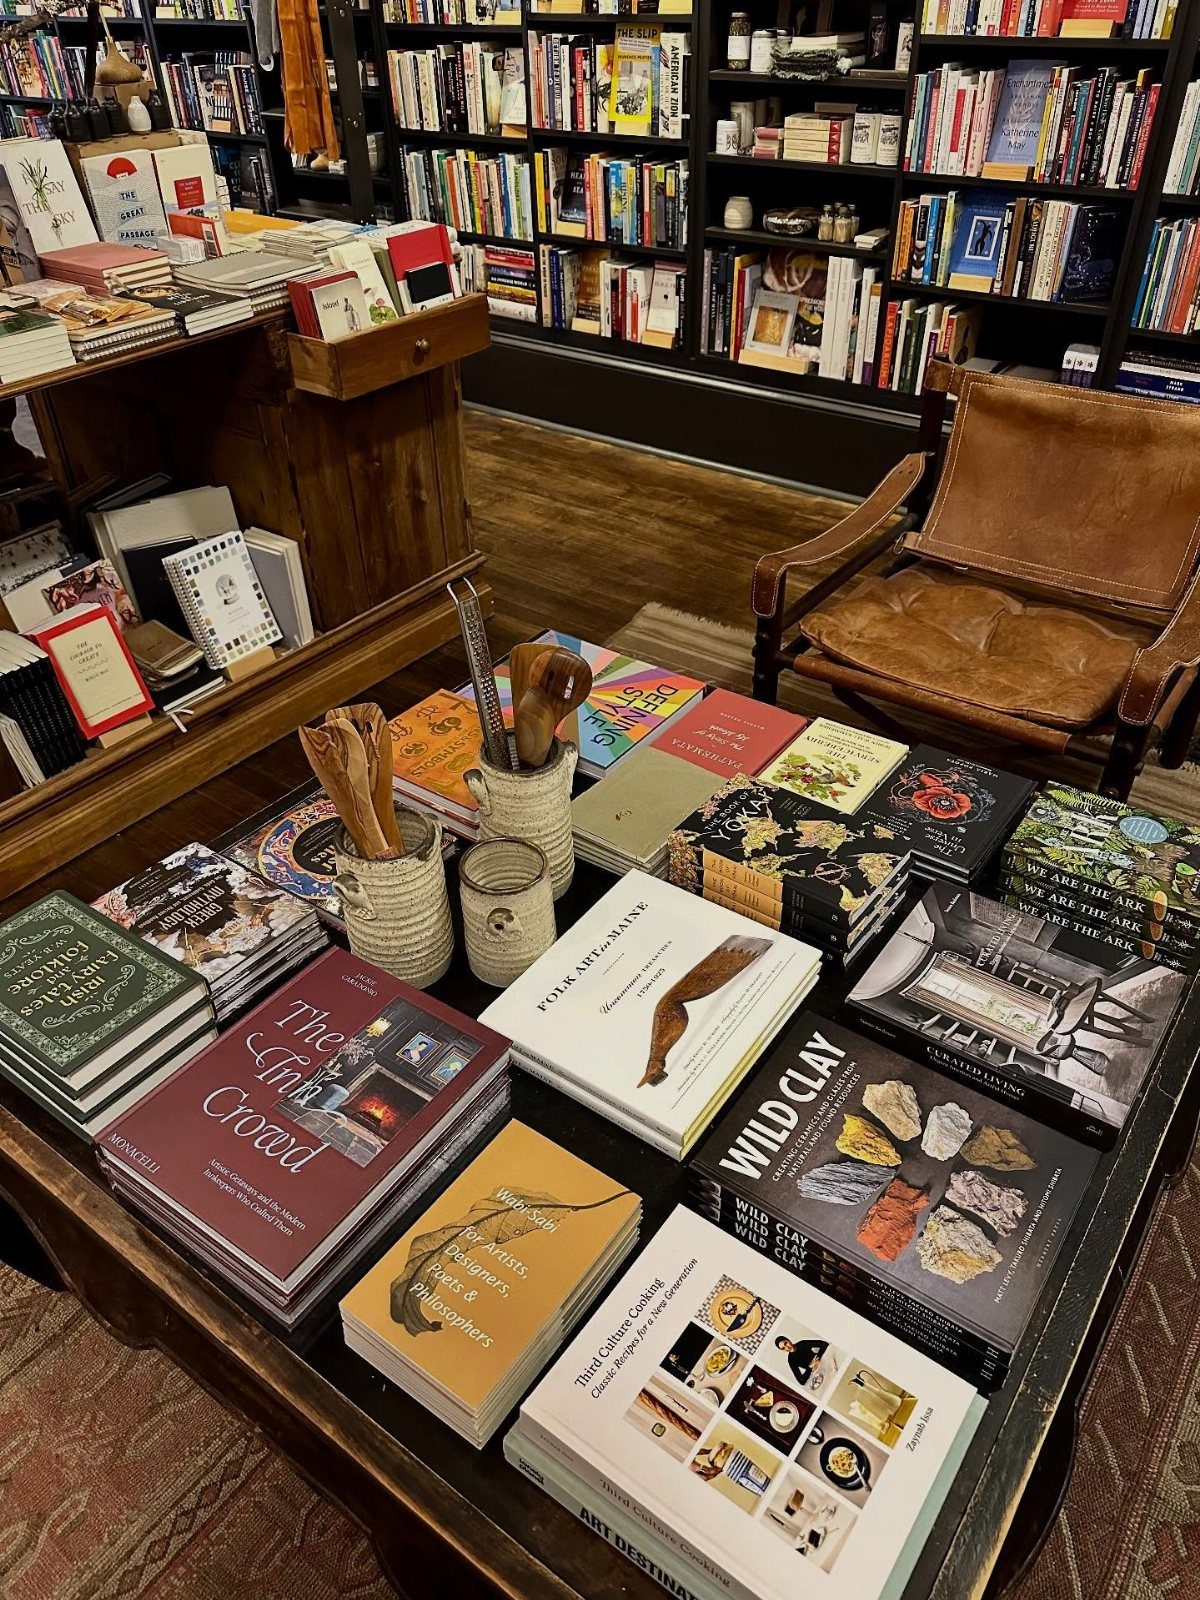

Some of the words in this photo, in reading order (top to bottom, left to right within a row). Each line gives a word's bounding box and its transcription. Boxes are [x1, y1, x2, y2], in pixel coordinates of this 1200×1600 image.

[617, 29, 633, 38] THE
[637, 29, 658, 38] SLIP
[670, 45, 680, 94] AMERICAN
[1007, 79, 1049, 88] Enchantme
[670, 98, 680, 118] ZION
[1001, 128, 1040, 138] Katherine
[1007, 141, 1026, 150] May
[45, 181, 67, 195] SAY
[120, 191, 136, 200] THE
[53, 210, 76, 226] SKY
[120, 207, 145, 220] GREAT
[120, 229, 155, 239] PASSAGE
[880, 316, 896, 377] LAPIDARIUM
[68, 646, 93, 660] COURAGE
[94, 641, 102, 649] TO
[76, 640, 89, 649] THE
[77, 651, 99, 664] CREATE
[582, 685, 646, 729] STYLE
[588, 683, 683, 749] DEFINING
[668, 737, 744, 769] PATHEMATA
[803, 734, 881, 765] SERVICEBERRY
[824, 748, 847, 759] THE
[944, 757, 974, 769] POPOVA
[974, 767, 999, 777] MARIA
[704, 818, 721, 831] THE
[720, 800, 741, 818] BOOK
[740, 791, 749, 800] OF
[921, 825, 949, 840] Verse
[921, 832, 967, 853] Universe
[950, 835, 962, 843] in
[930, 843, 955, 856] The
[1026, 862, 1047, 878] WE
[1050, 870, 1078, 889] ARE
[1082, 882, 1110, 901] THE
[1113, 893, 1146, 913] ARK
[152, 885, 228, 930] MYTHOLOGY
[181, 901, 225, 928] GREEK
[603, 900, 649, 941] MAINE
[1024, 882, 1045, 898] WE
[1048, 890, 1076, 909] ARE
[1079, 902, 1107, 921] THE
[1110, 913, 1142, 933] ARK
[975, 934, 1001, 967] CURATED
[995, 912, 1015, 936] LIVING
[1018, 900, 1039, 917] WE
[1041, 909, 1069, 930] ARE
[1072, 920, 1100, 941] THE
[1102, 931, 1134, 954] ARK
[571, 947, 603, 975] ART
[595, 938, 613, 952] in
[1, 952, 42, 979] YEATS
[44, 965, 74, 984] and
[354, 972, 377, 986] JACKIE
[596, 970, 643, 1016] Uncommon
[640, 939, 673, 972] TREASURES
[339, 973, 378, 997] CARADONIO
[535, 974, 577, 1012] FOLK
[635, 966, 666, 998] 1750-1925
[274, 999, 348, 1055] The
[245, 1030, 348, 1122] Inn
[926, 1044, 982, 1077] CURATED
[982, 1071, 1025, 1098] LIVING
[714, 1094, 807, 1186] WILD
[770, 1030, 853, 1108] CLAY
[770, 1147, 800, 1182] CREATING
[792, 1114, 821, 1147] CERAMICS
[815, 1100, 831, 1116] AND
[824, 1077, 846, 1101] GLAZES
[840, 1060, 858, 1079] FROM
[195, 1076, 332, 1177] Crowd
[785, 1146, 813, 1178] NATURAL
[806, 1130, 822, 1147] AND
[816, 1106, 839, 1132] FOUND
[832, 1072, 862, 1108] RESOURCES
[106, 1132, 161, 1174] MONACELLI
[1047, 1166, 1064, 1190] SHIBATA
[201, 1166, 239, 1196] Innkeepers
[233, 1190, 254, 1206] Who
[248, 1200, 276, 1223] Crafted
[270, 1217, 295, 1237] Them
[207, 1157, 232, 1176] Artistic
[226, 1171, 261, 1198] Getaways
[255, 1191, 273, 1206] and
[267, 1200, 283, 1213] the
[278, 1207, 308, 1232] Modern
[493, 1185, 561, 1235] Wabi-Sabi
[1037, 1188, 1053, 1210] HITOMI
[735, 1196, 769, 1227] WILD
[775, 1220, 808, 1250] CLAY
[1031, 1208, 1044, 1223] AND
[734, 1221, 767, 1251] WILD
[773, 1244, 806, 1274] CLAY
[735, 1209, 768, 1239] WILD
[774, 1232, 807, 1262] CLAY
[1020, 1220, 1038, 1247] SHIBATA
[459, 1223, 486, 1246] for
[479, 1238, 534, 1281] Artists,
[1008, 1244, 1026, 1270] TAKURO
[425, 1261, 467, 1296] Poets
[461, 1287, 479, 1305] &
[441, 1242, 515, 1301] Designers,
[661, 1256, 701, 1301] Generation
[1000, 1267, 1016, 1287] LEVY,
[648, 1297, 669, 1320] New
[992, 1284, 1007, 1304] MATT
[406, 1279, 496, 1354] Philosophers
[572, 1356, 603, 1389] Third
[595, 1316, 634, 1359] Culture
[625, 1275, 667, 1322] Cooking
[632, 1322, 652, 1341] for
[645, 1317, 655, 1326] a
[610, 1335, 643, 1370] Recipes
[587, 1366, 618, 1400] Classic
[901, 1420, 930, 1453] Zaynab
[918, 1404, 936, 1424] Issa
[580, 1507, 614, 1539] ART
[600, 1479, 630, 1507] Third
[633, 1509, 677, 1544] Culture
[680, 1543, 731, 1588] Cooking
